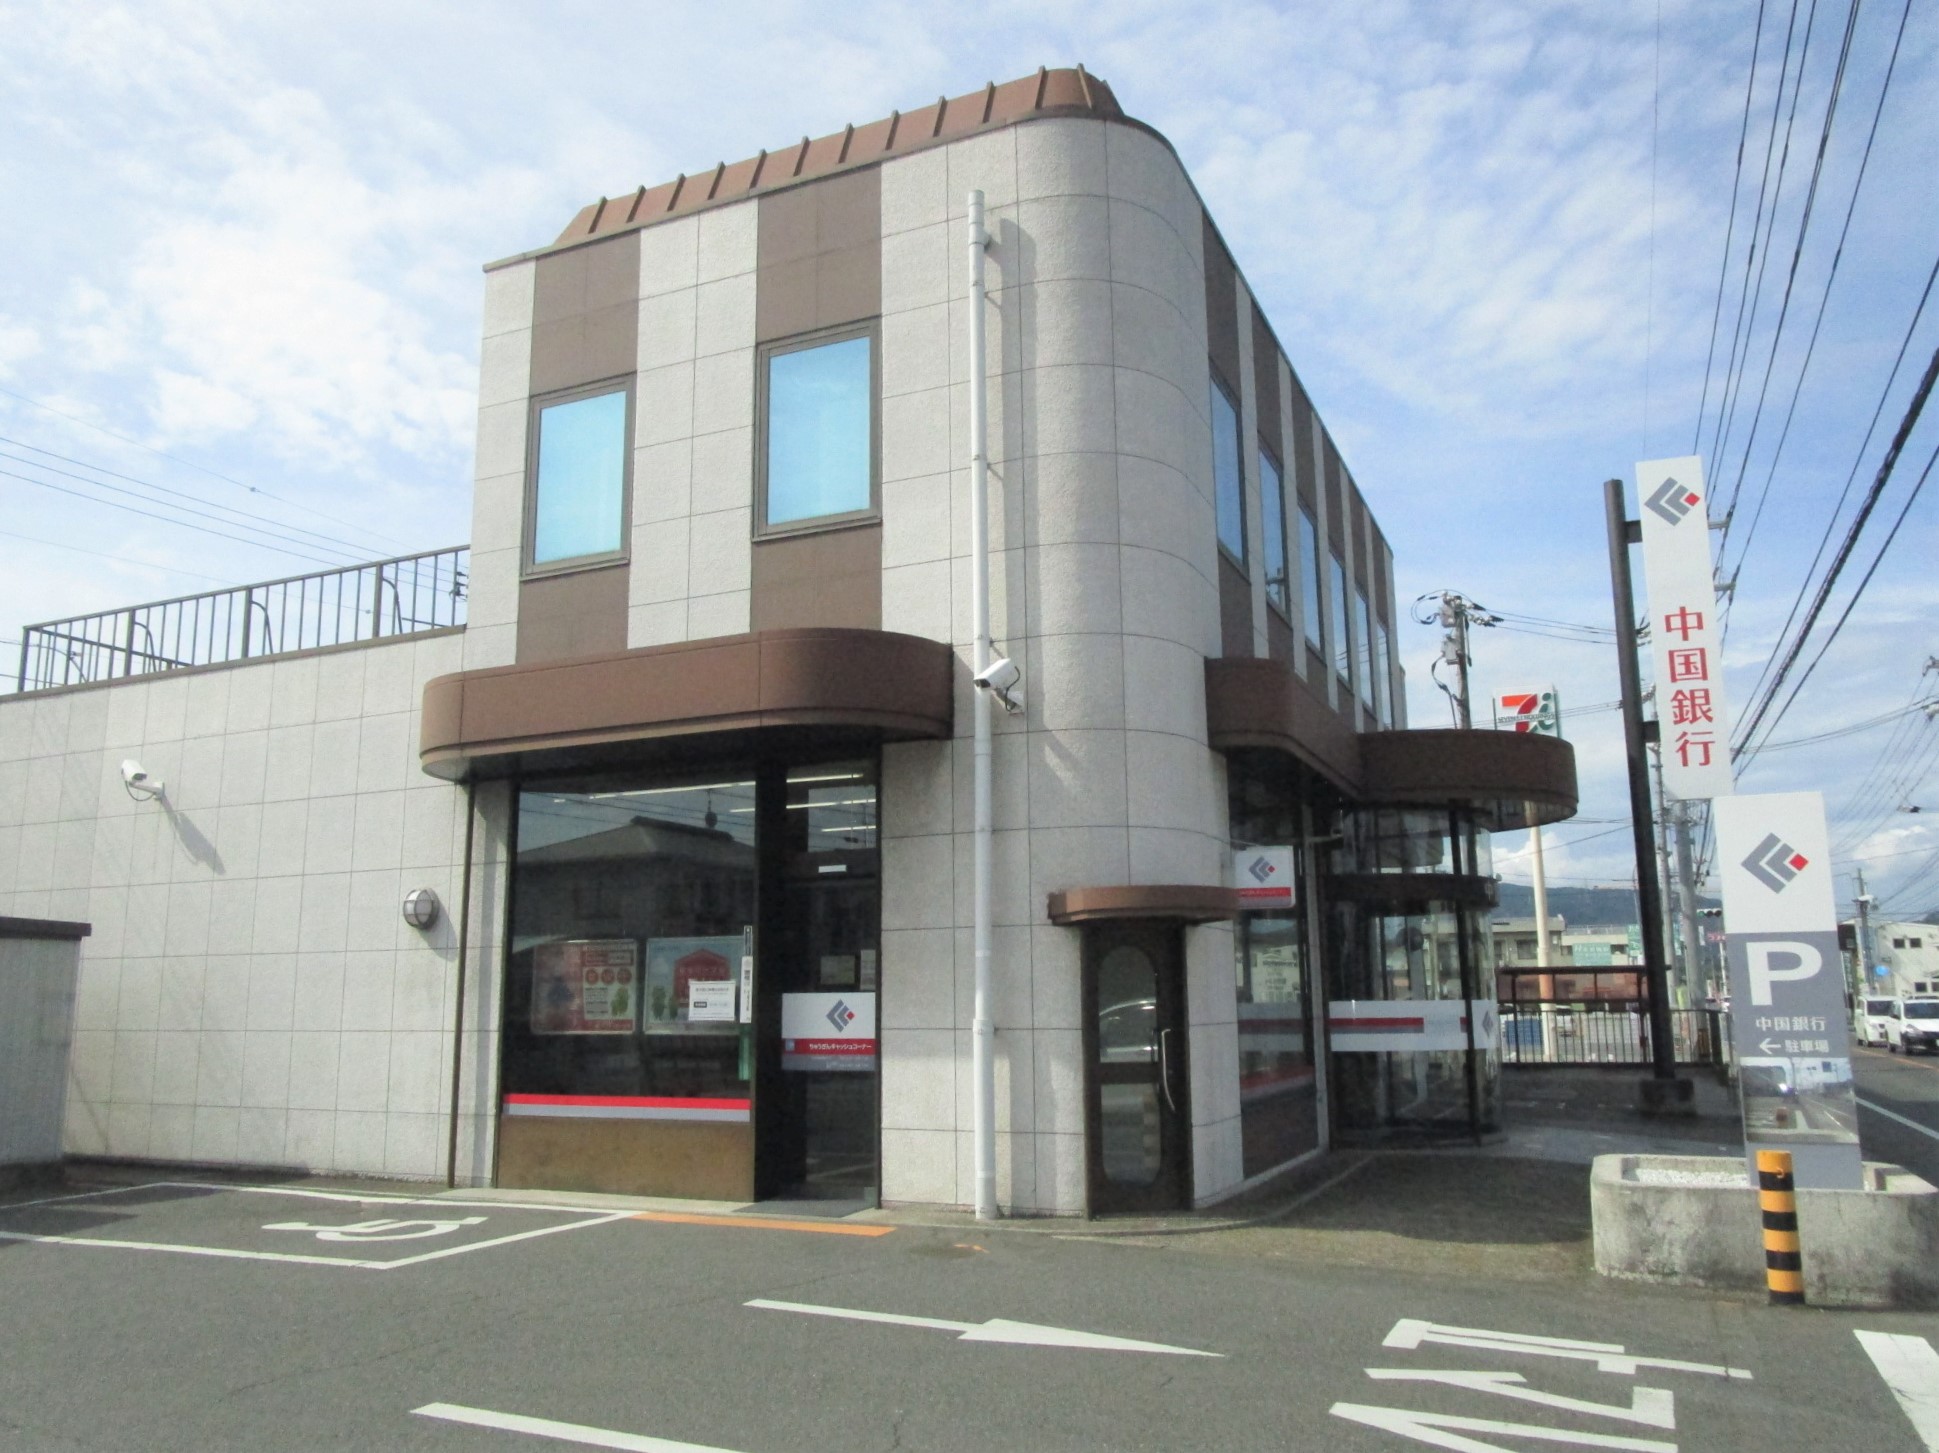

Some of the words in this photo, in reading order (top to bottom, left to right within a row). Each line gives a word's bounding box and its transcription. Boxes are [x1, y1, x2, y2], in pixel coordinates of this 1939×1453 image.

[1664, 606, 1716, 768] 中国銀行
[1746, 941, 1822, 1006] P
[1755, 1016, 1826, 1031] 中国銀行
